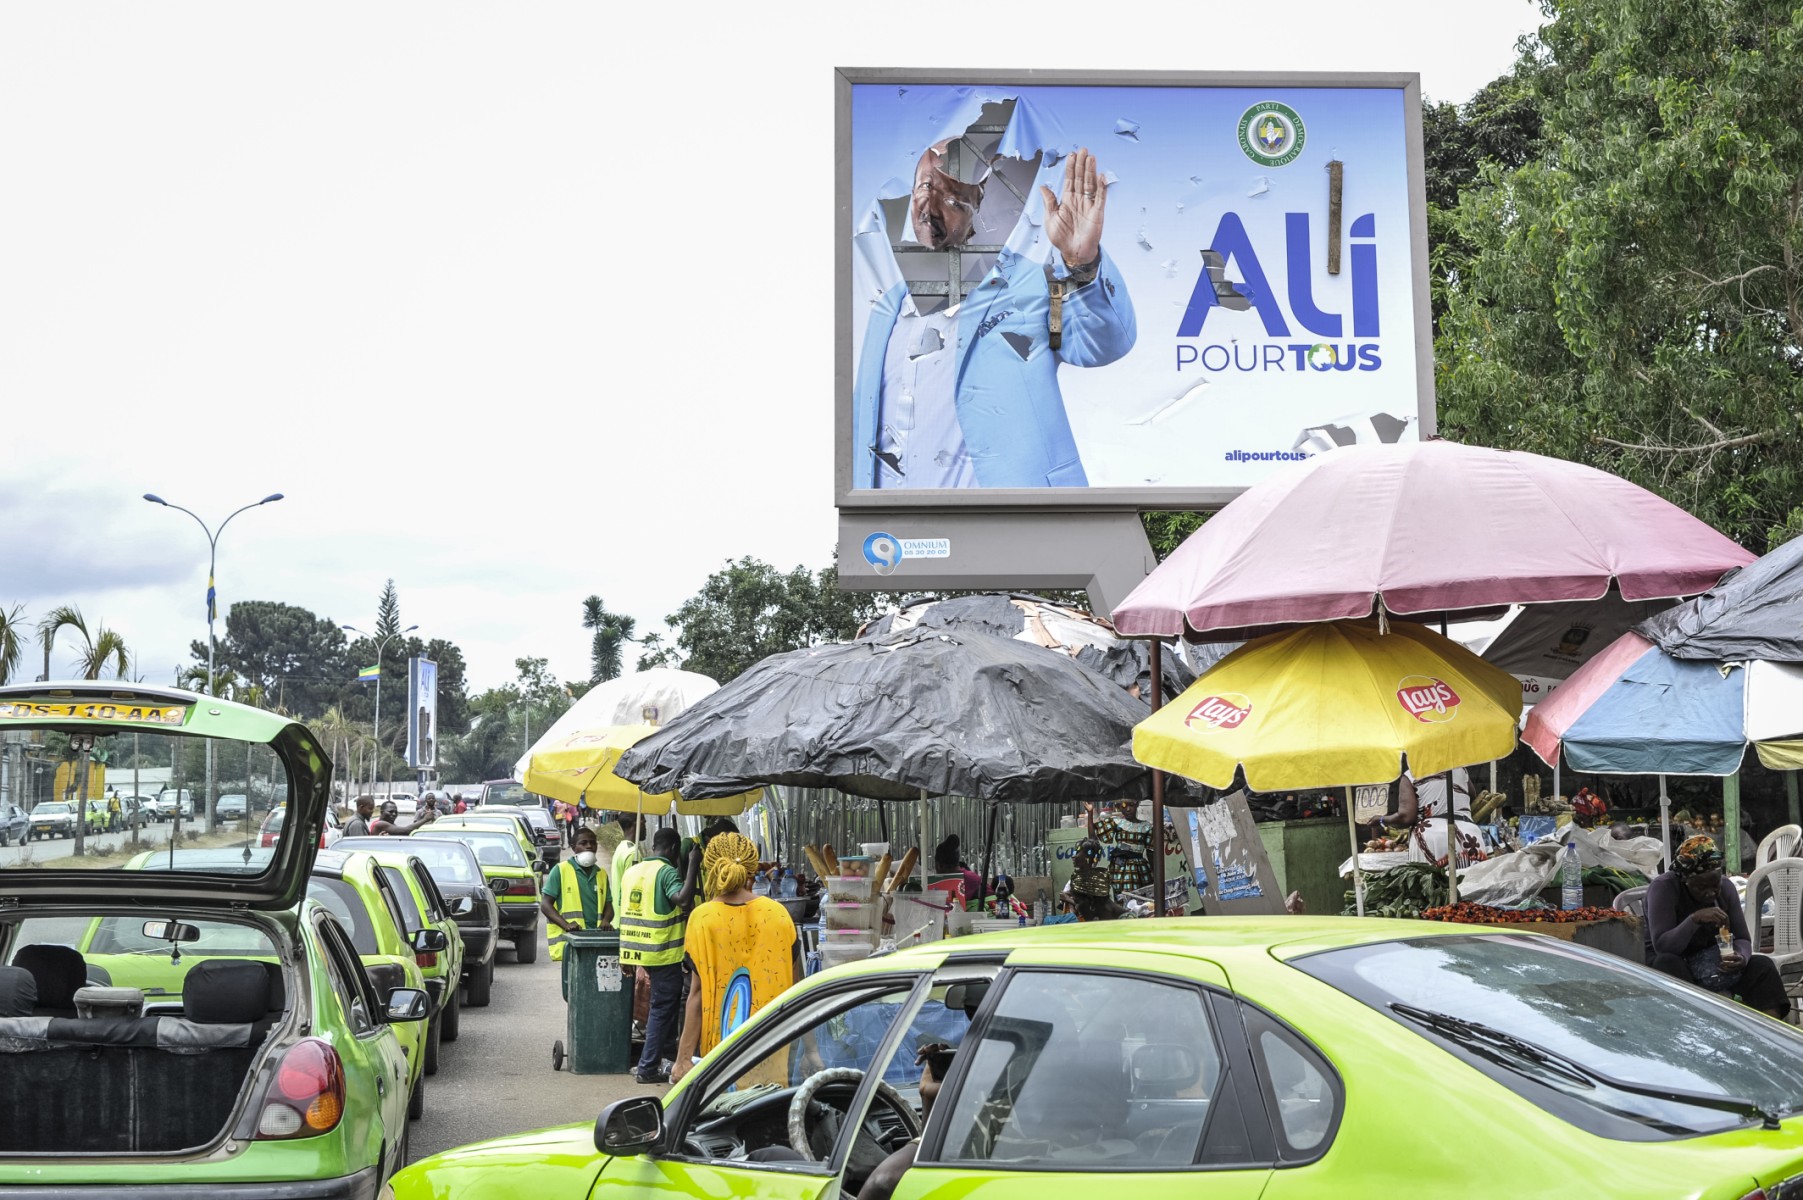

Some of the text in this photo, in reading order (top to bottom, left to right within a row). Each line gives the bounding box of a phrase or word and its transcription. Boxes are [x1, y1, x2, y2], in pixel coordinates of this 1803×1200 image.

[1255, 103, 1279, 112] PARTI
[1239, 119, 1255, 158] GABONAIS
[1224, 450, 1316, 463] alipourtous
[903, 541, 948, 549] OMNIUM
[1400, 683, 1452, 714] Lay's
[1190, 697, 1249, 729] Lay's
